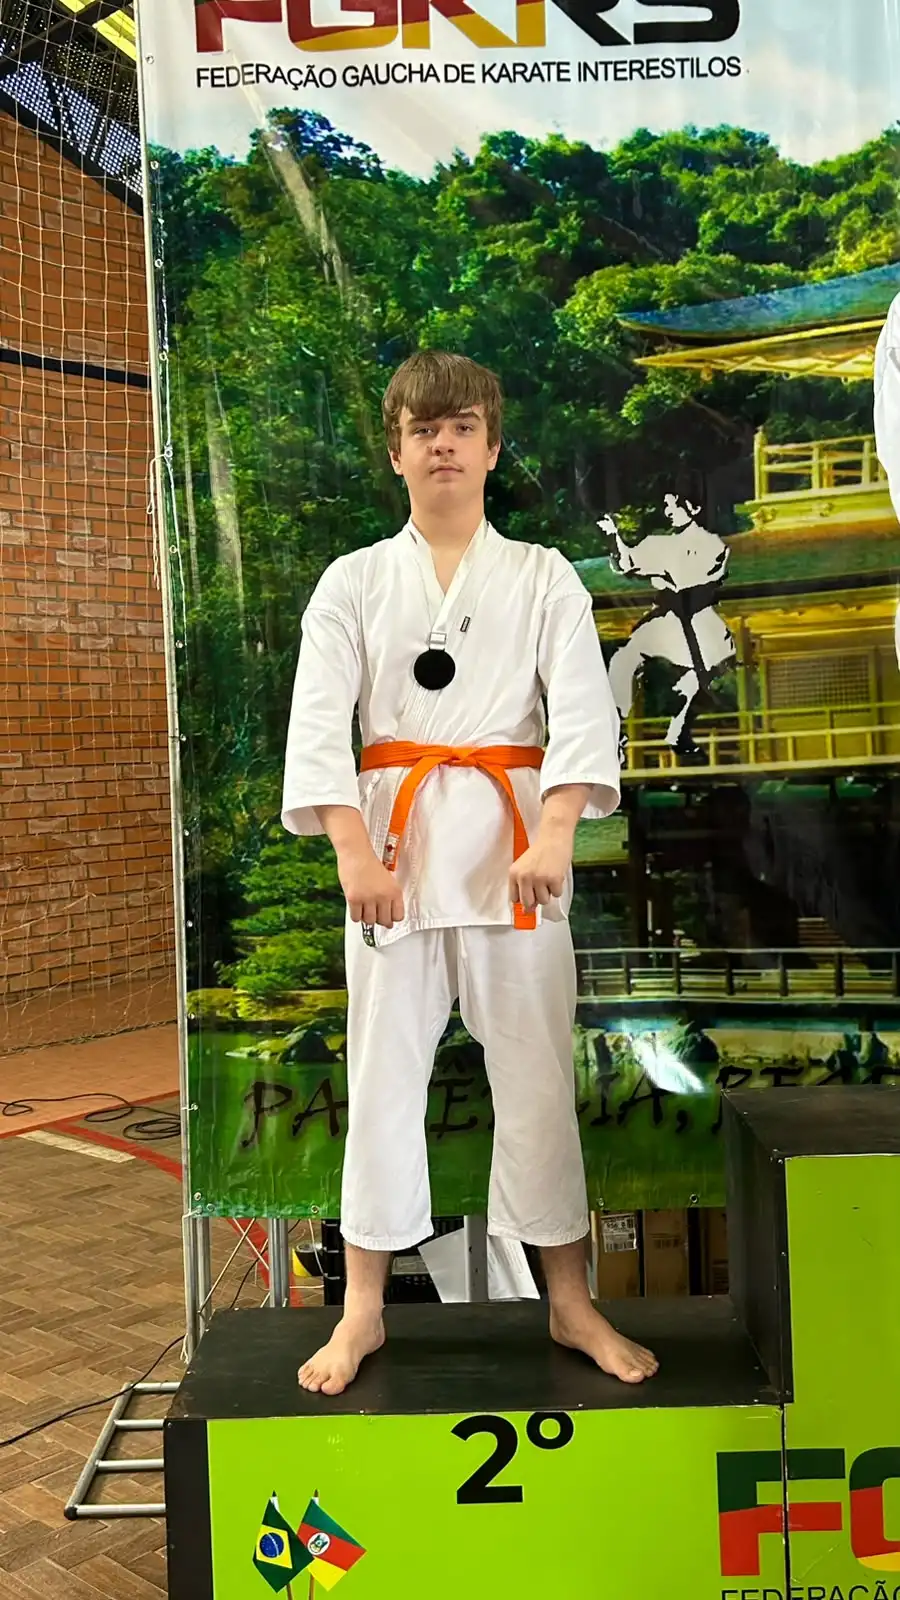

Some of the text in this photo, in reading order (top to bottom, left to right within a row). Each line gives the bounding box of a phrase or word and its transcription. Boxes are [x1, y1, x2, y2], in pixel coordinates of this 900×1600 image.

[196, 56, 742, 90] FEDERAÇÃO GAUCHA DE KARATE INTERESTILOS
